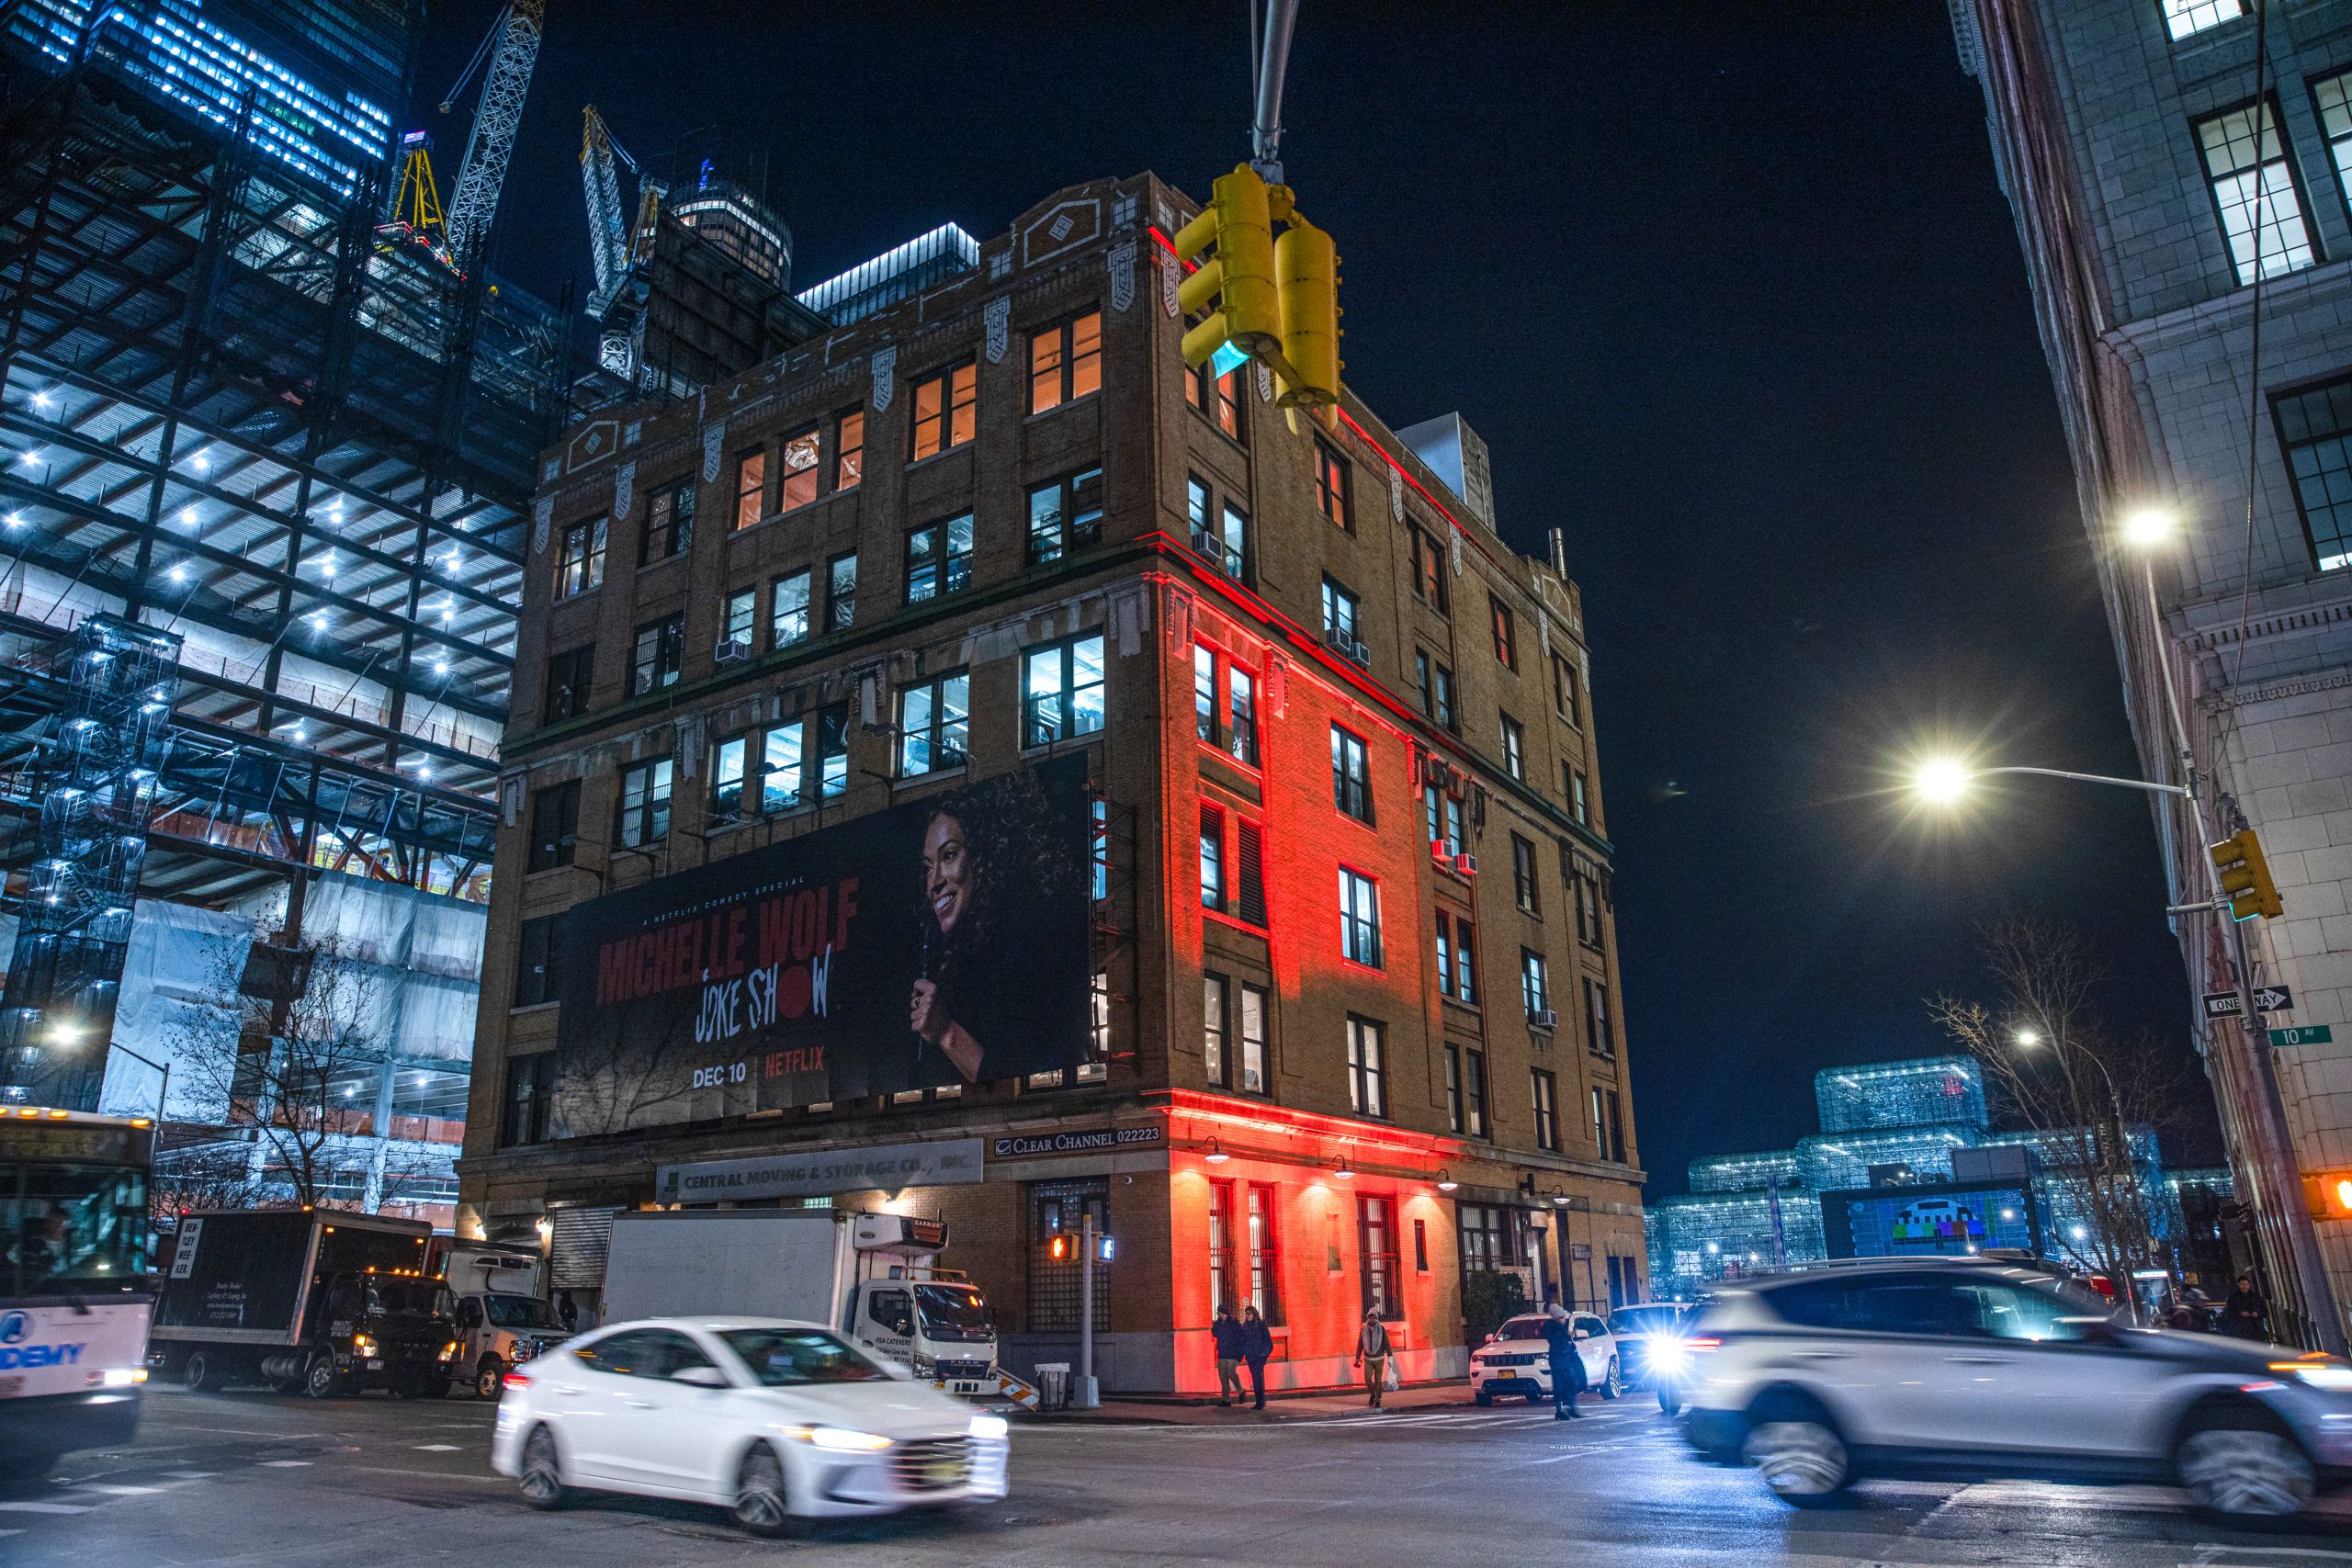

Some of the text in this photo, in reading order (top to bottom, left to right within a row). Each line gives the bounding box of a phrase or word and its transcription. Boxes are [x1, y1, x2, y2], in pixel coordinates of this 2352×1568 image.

[654, 905, 698, 923] NETFLIX
[705, 892, 748, 908] COMEDY
[755, 876, 804, 895] SPECIAL
[597, 876, 860, 1004] MICHELLE WOLF
[695, 968, 742, 1043] JOKE
[2216, 998, 2241, 1010] ONE
[2282, 1028, 2314, 1044] 10 AV
[693, 1062, 747, 1089] DEC 10
[764, 1044, 825, 1080] NETFLIX
[1013, 1127, 1159, 1154] CLEAR CHANNEL 022223
[684, 1172, 744, 1190] CENTRAL
[747, 1166, 807, 1185] MOVING
[808, 1166, 820, 1180] &
[825, 1160, 898, 1179] STORAGE
